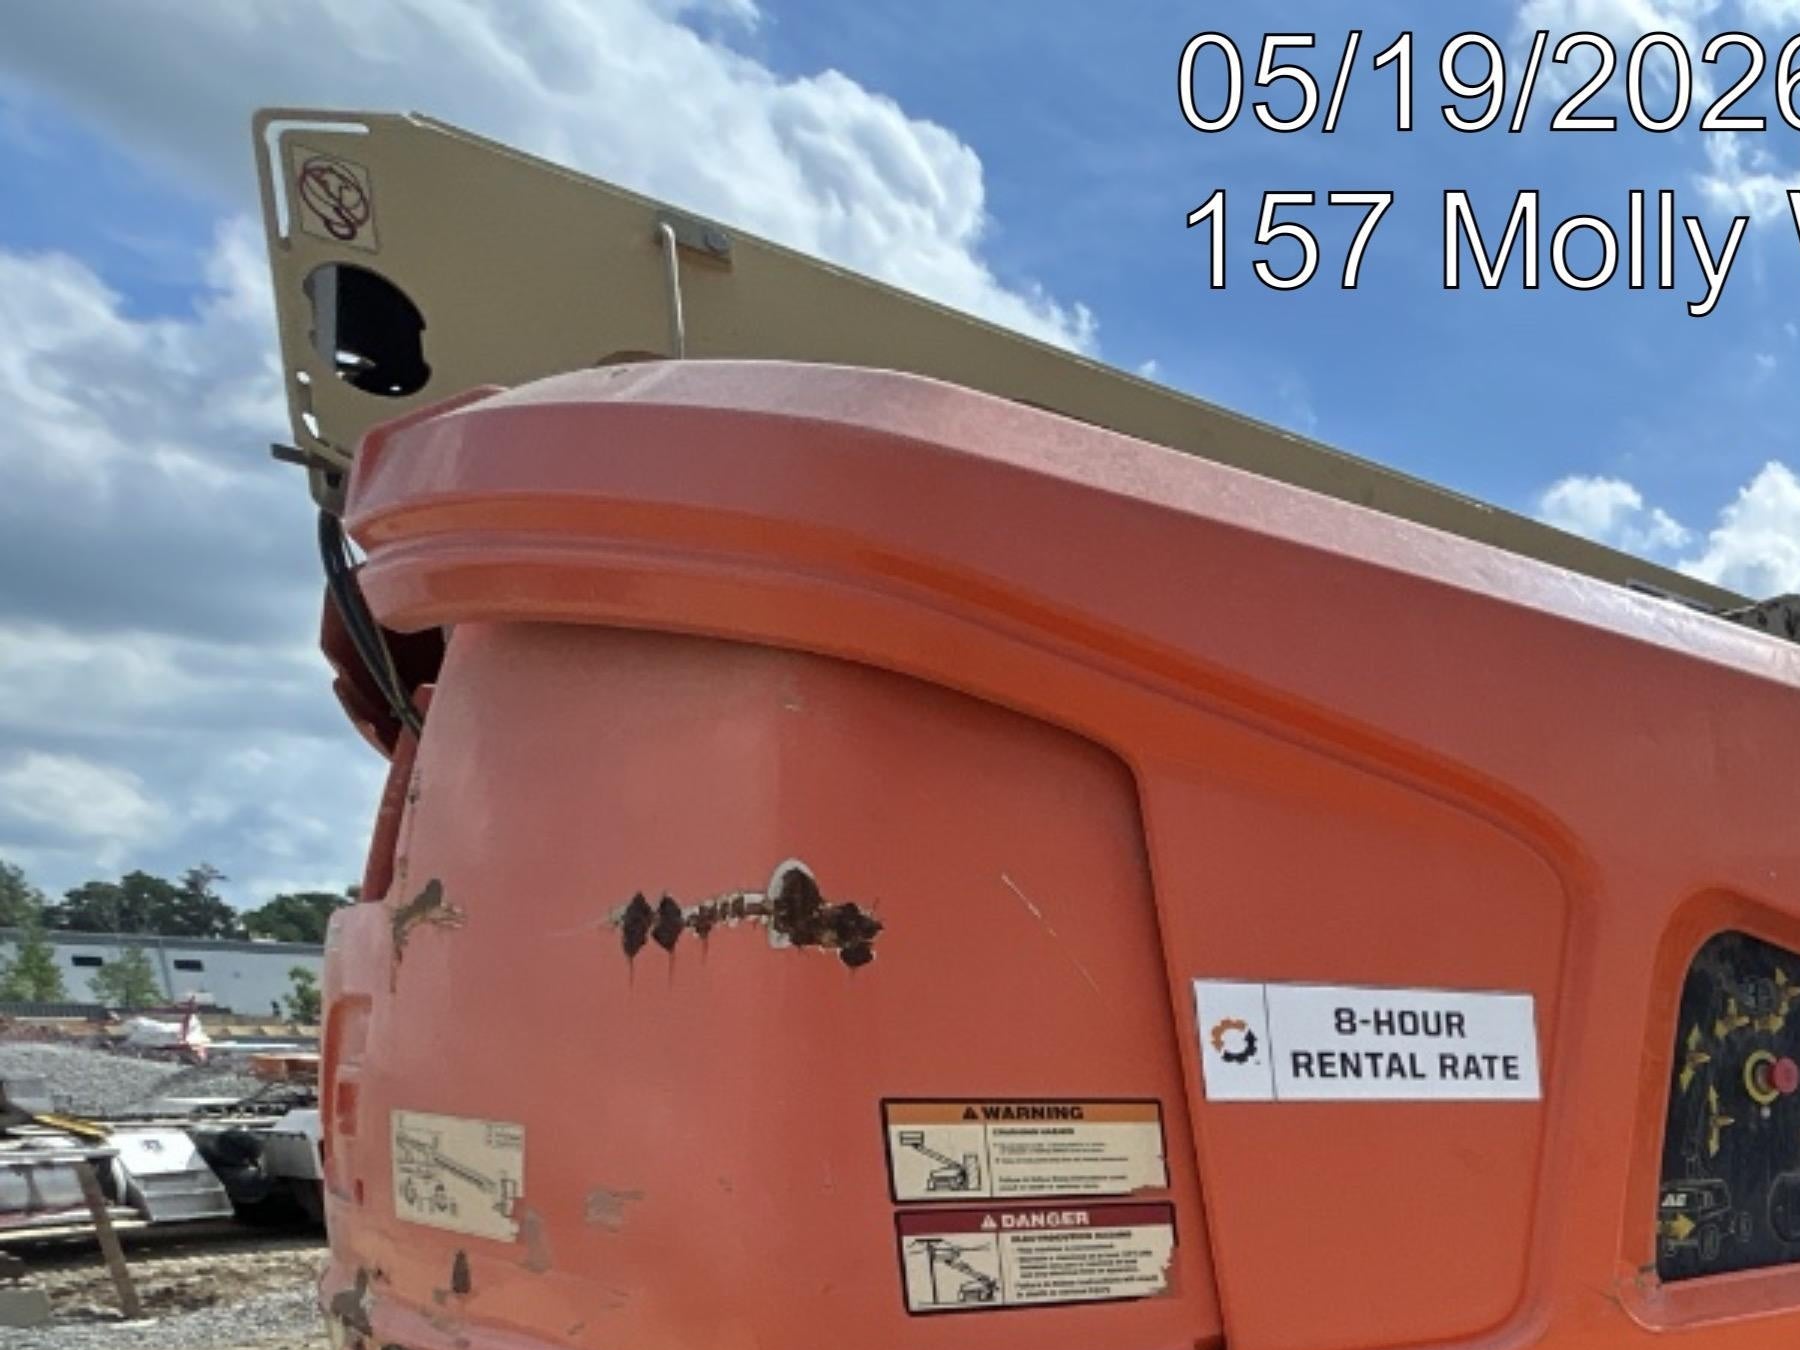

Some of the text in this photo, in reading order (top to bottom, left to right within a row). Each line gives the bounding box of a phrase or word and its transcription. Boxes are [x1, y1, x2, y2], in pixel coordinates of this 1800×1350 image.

[1333, 1006, 1467, 1039] 8-HOUR
[1290, 1051, 1521, 1081] RENTAL RATE
[981, 1106, 1085, 1120] WARNING
[1000, 1211, 1090, 1229] DANGER
